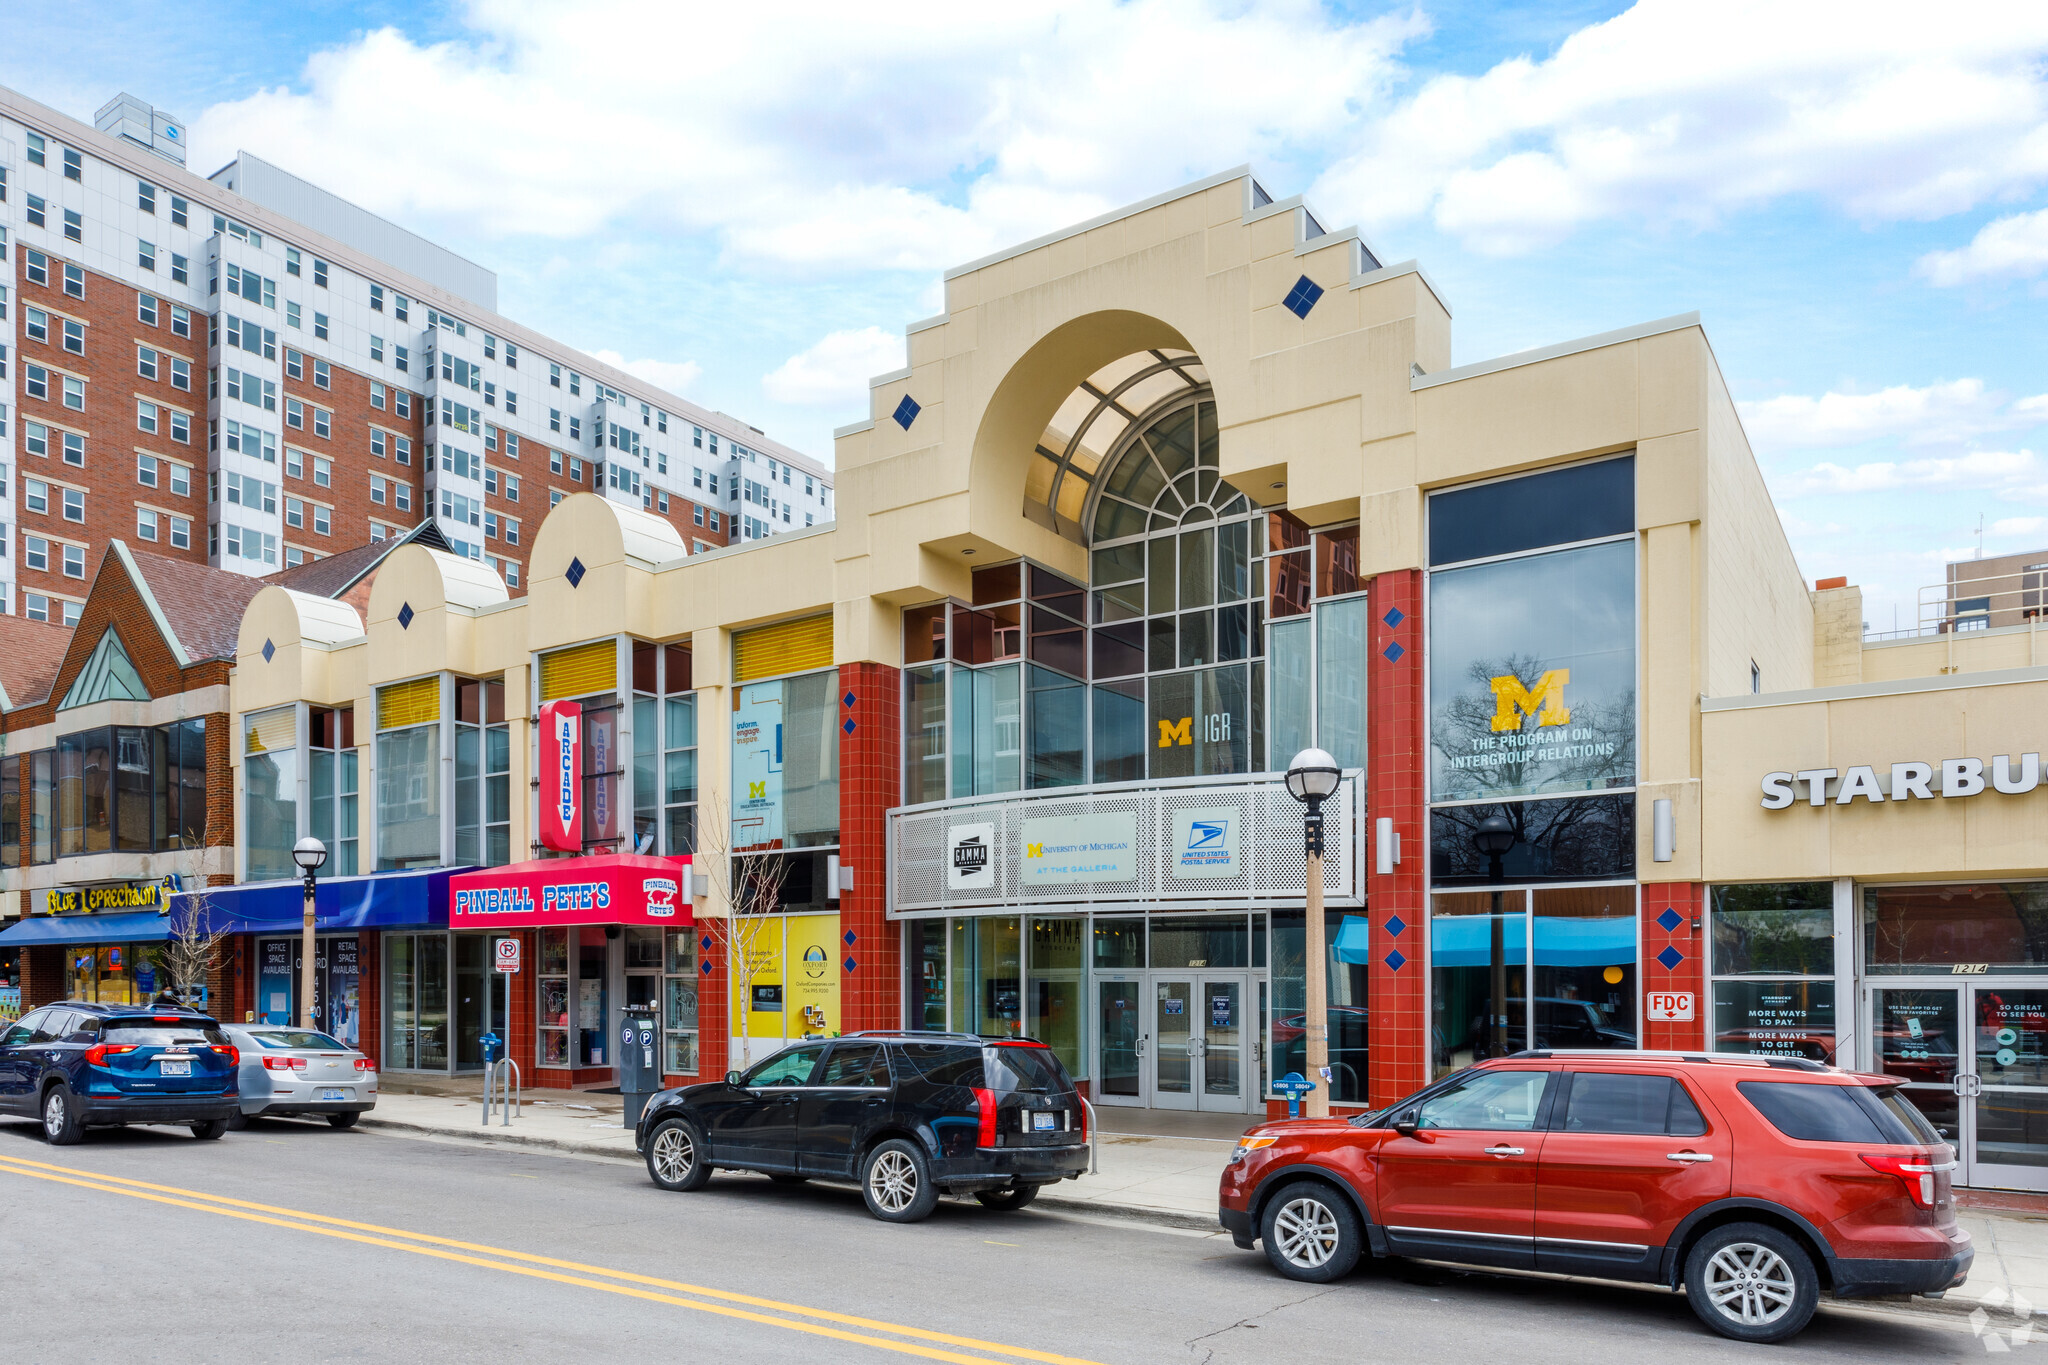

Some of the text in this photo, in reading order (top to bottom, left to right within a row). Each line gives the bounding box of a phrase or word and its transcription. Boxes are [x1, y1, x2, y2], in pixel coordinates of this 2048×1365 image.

[1491, 668, 1570, 732] M
[736, 721, 759, 729] inform.
[1158, 712, 1231, 748] M IGR
[736, 727, 761, 737] engage.
[736, 736, 760, 745] inspire.
[1472, 727, 1593, 750] THE PROGRAM ON
[1451, 742, 1615, 769] INTERGROUP RELATIONS
[562, 722, 571, 821] ARCADE
[1760, 752, 2048, 810] STARBU
[749, 781, 766, 799] M
[1040, 845, 1078, 854] UNIVERSITY
[1089, 843, 1128, 851] MICHIGAN
[955, 847, 986, 862] GAMMA
[1070, 864, 1118, 873] GALLERIA
[645, 880, 676, 891] PINBALL
[456, 882, 610, 915] PINBALL PETE'S
[649, 905, 673, 915] PETE'S
[1035, 919, 1080, 944] GAMMA
[267, 943, 286, 952] OFFICE
[338, 942, 358, 951] RETAIL
[268, 954, 285, 963] SPACE
[338, 953, 357, 963] SPACE
[263, 965, 291, 975] AVAILABLE
[332, 965, 360, 975] AVAILABL
[1955, 964, 1987, 973] 1214
[1653, 995, 1689, 1011] FDC
[1779, 1032, 1807, 1040] WAYS
